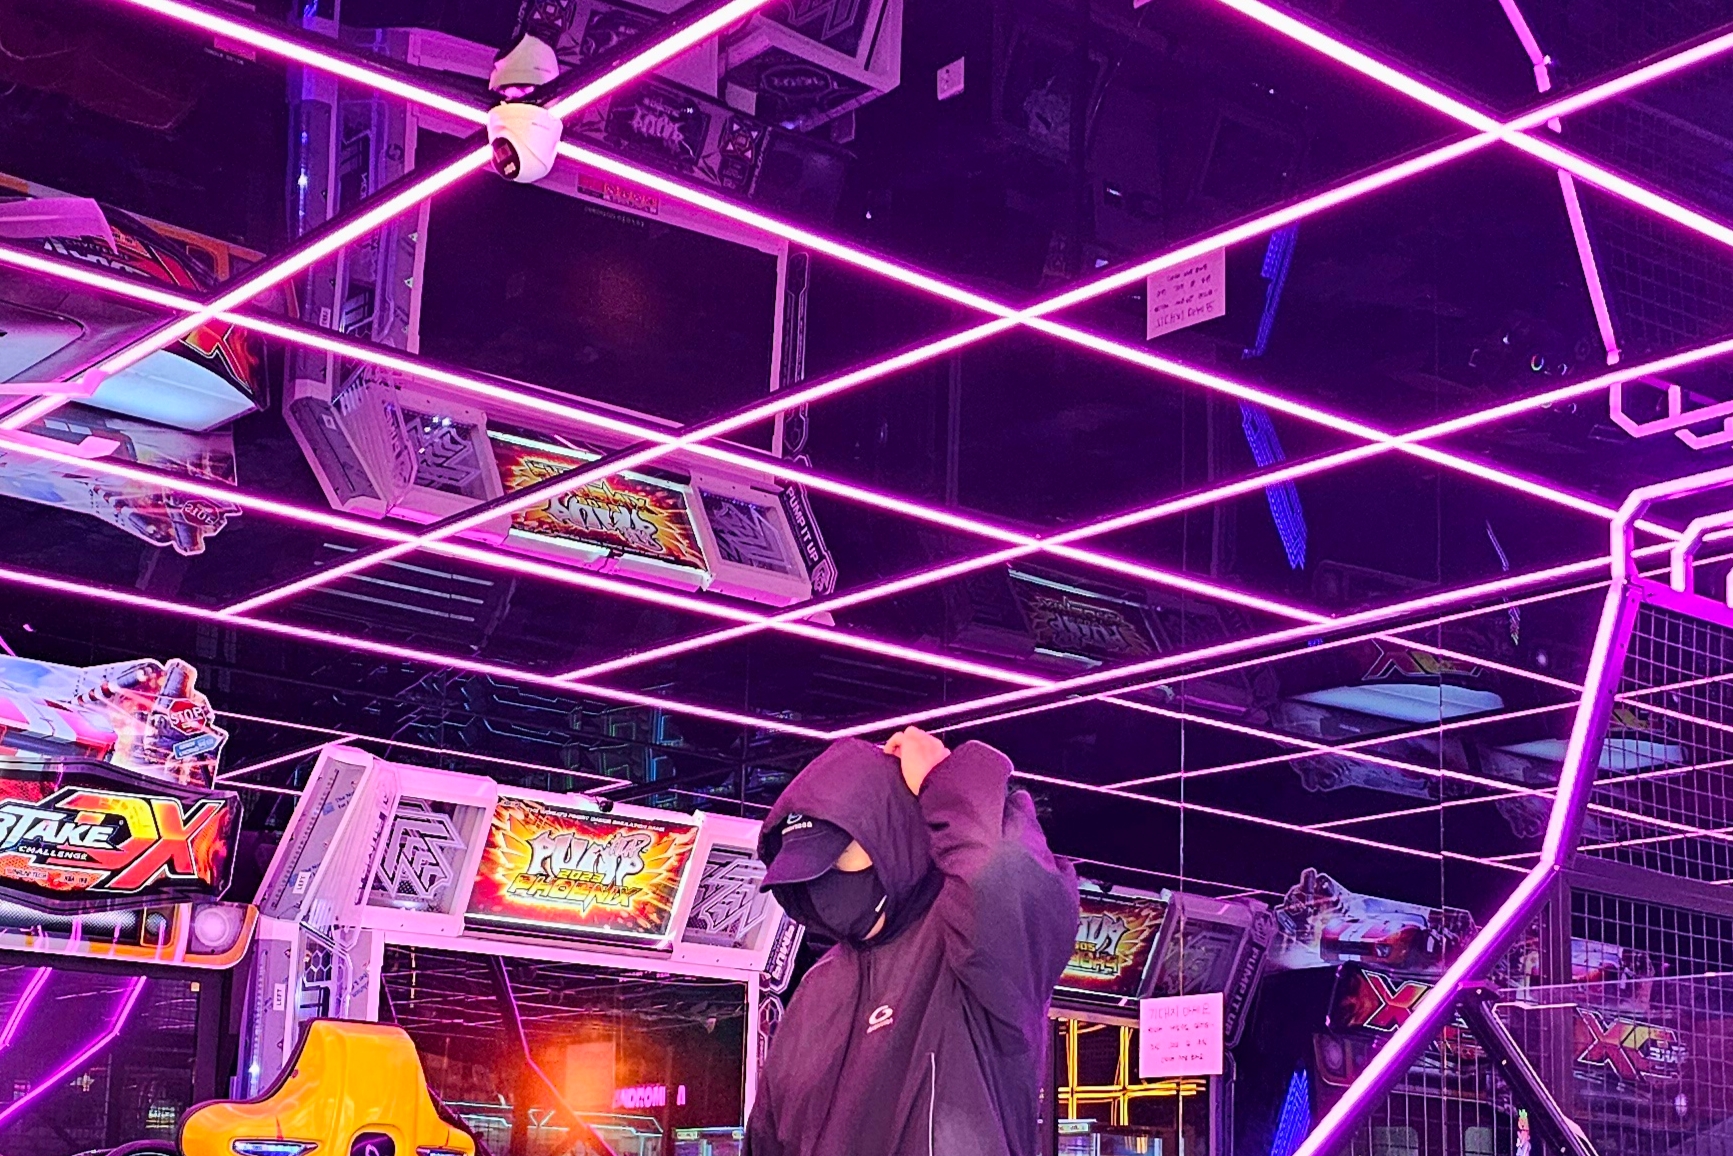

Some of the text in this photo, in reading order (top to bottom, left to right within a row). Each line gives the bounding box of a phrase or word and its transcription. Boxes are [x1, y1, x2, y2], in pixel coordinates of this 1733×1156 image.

[786, 486, 819, 562] PUMP IT UP
[171, 707, 203, 724] STOP
[18, 844, 88, 861] CHALLENGE
[526, 830, 648, 886] PUMP
[296, 875, 305, 892] LEFT
[557, 868, 607, 885] 2023
[507, 873, 644, 909] PHOENIX
[1240, 946, 1260, 994] PUMP
